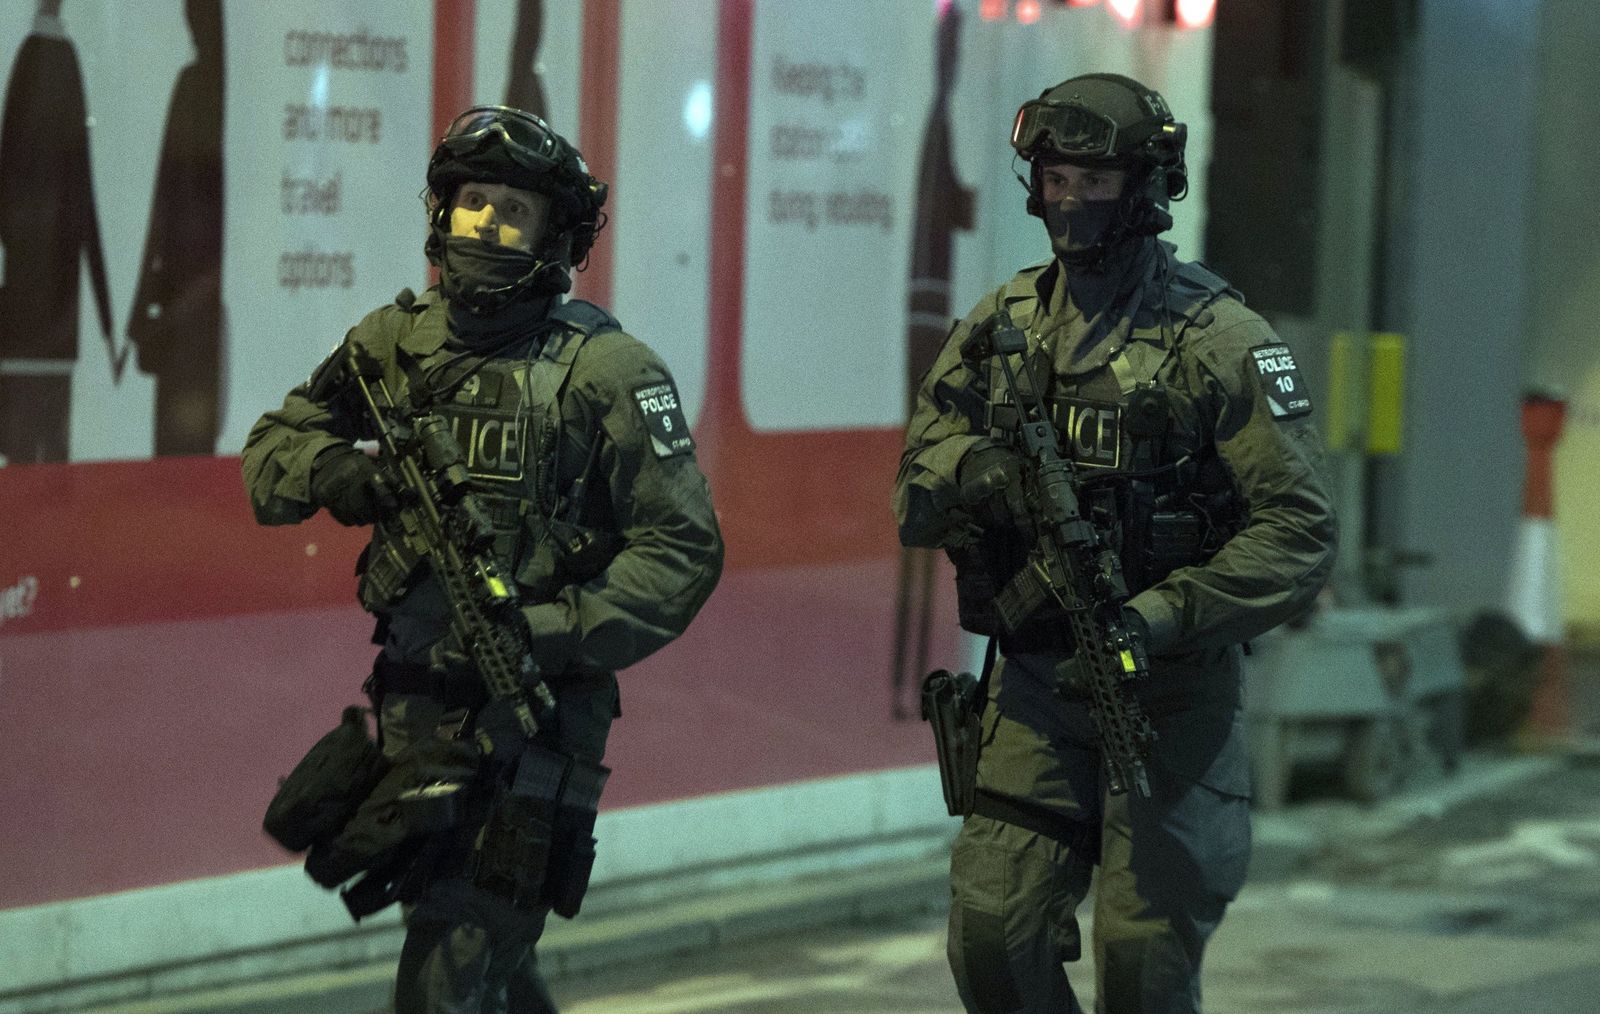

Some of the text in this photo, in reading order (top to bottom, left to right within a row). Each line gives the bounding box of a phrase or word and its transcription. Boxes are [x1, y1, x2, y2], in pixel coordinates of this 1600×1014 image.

[278, 245, 355, 294] options
[1257, 355, 1297, 375] POLICE
[1275, 375, 1295, 393] 10
[640, 393, 677, 416] POLICE
[662, 415, 673, 432] 9
[1053, 403, 1115, 460] ICE
[451, 416, 521, 471] ICE
